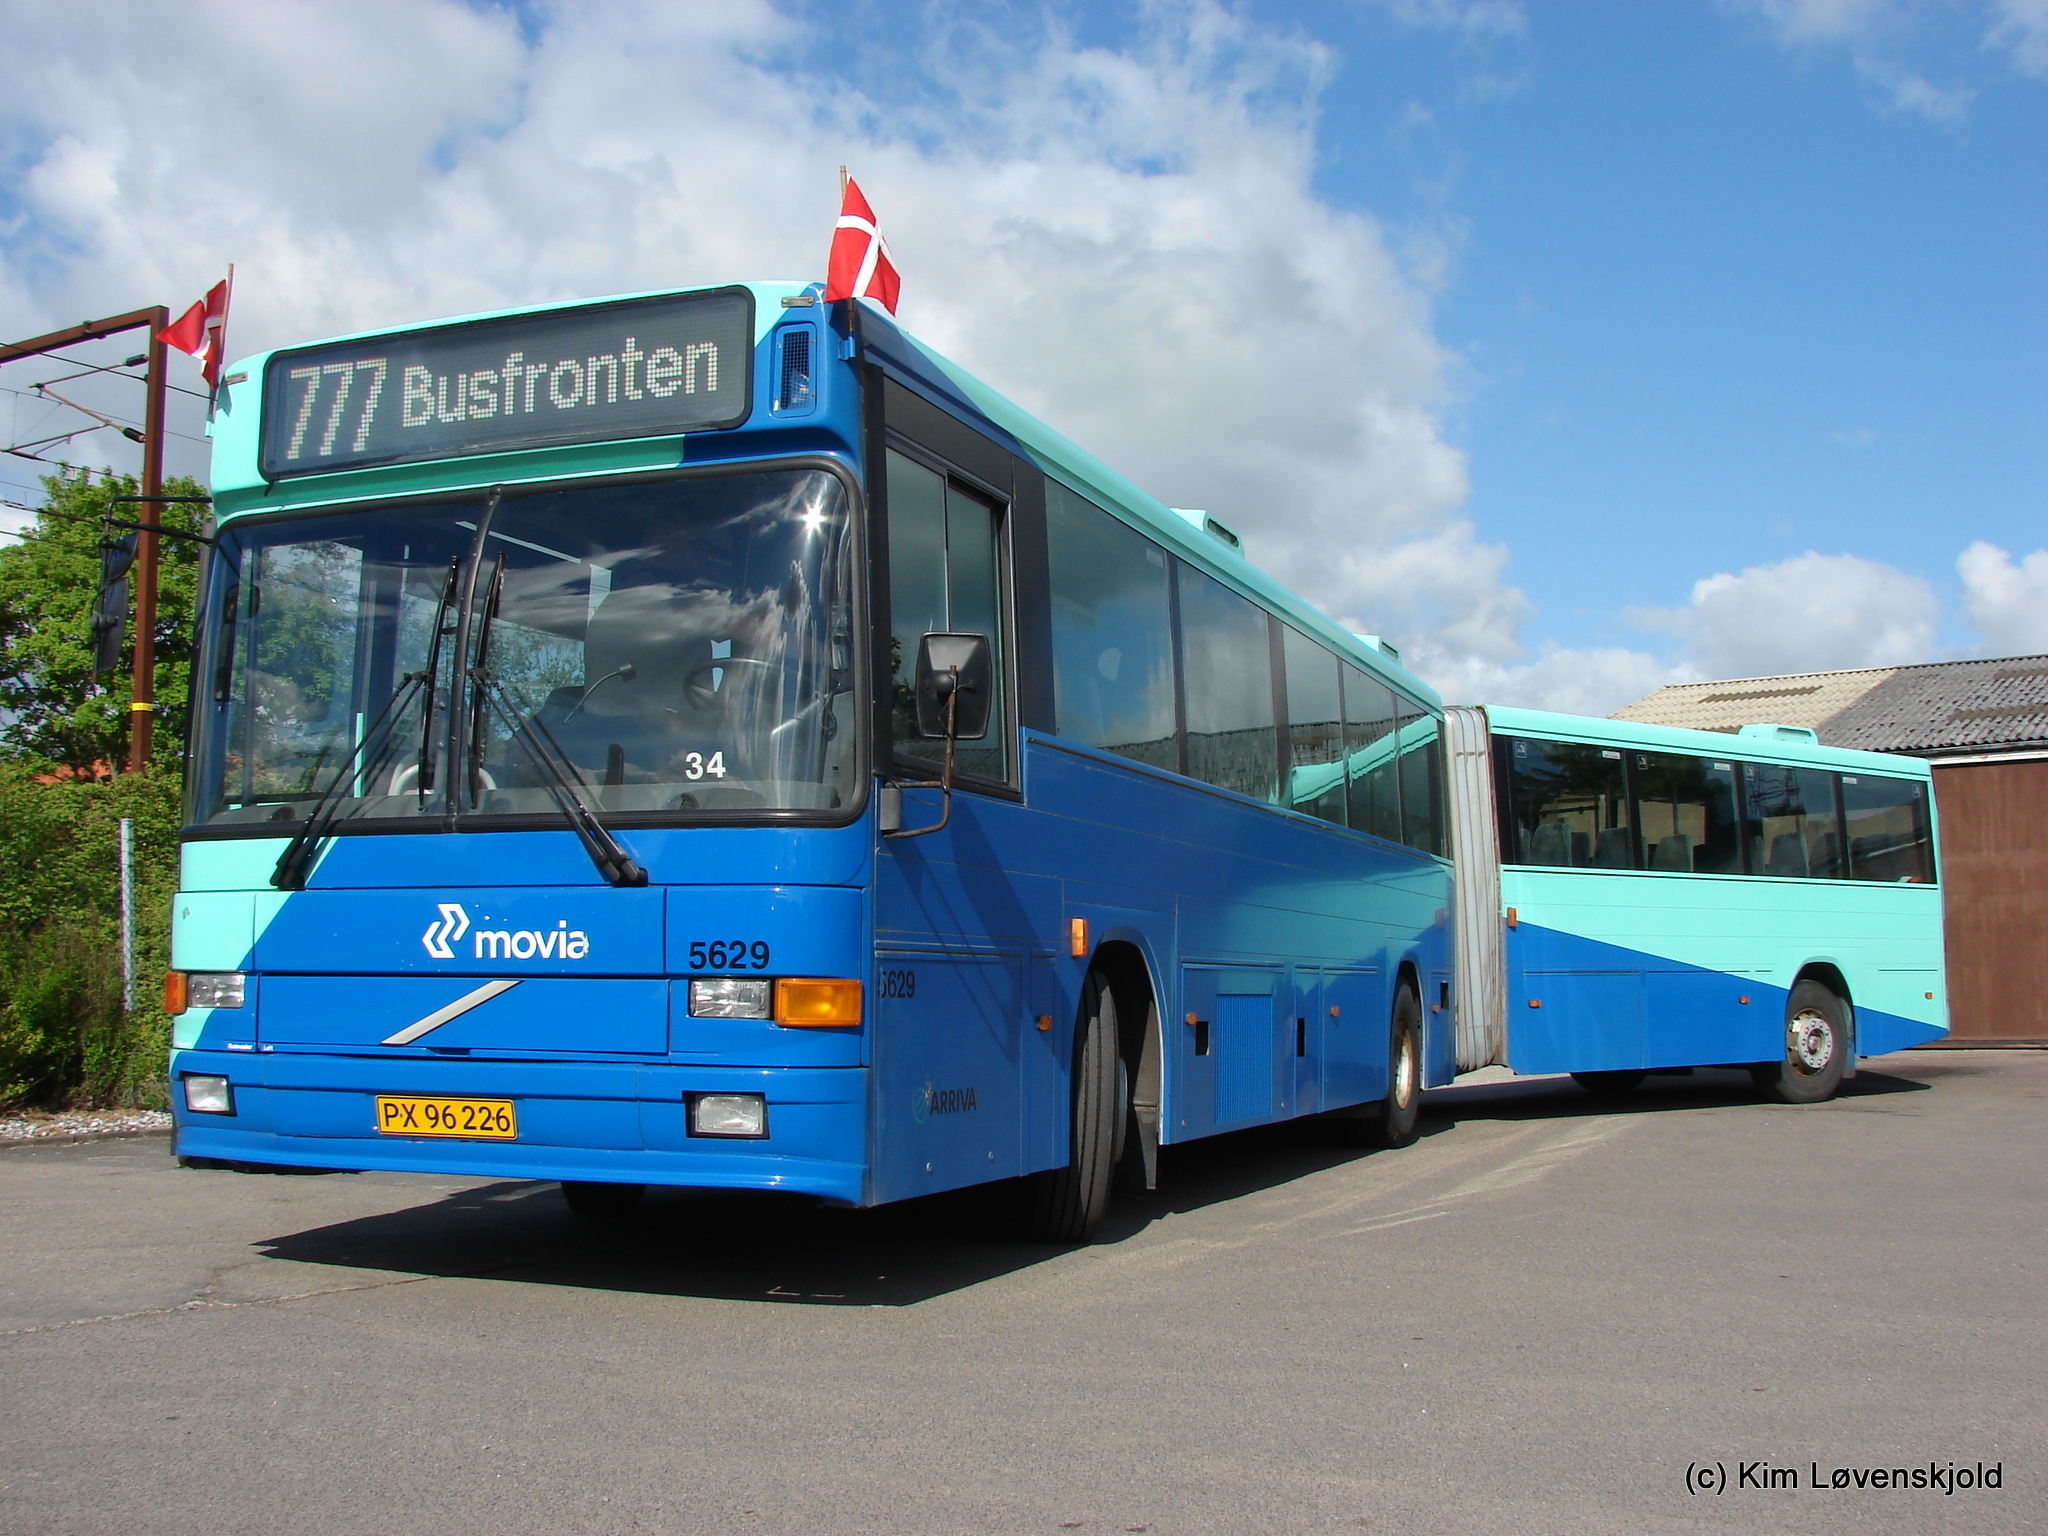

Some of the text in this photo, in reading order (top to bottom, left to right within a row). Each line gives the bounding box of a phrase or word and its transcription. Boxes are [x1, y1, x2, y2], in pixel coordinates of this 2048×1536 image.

[287, 337, 718, 460] 777 Busfronten
[685, 751, 727, 780] 34
[475, 919, 590, 960] movia
[688, 940, 770, 970] 5629
[877, 970, 916, 999] 5629
[929, 1087, 977, 1116] ARRIVA
[383, 1102, 511, 1132] PX 96 226
